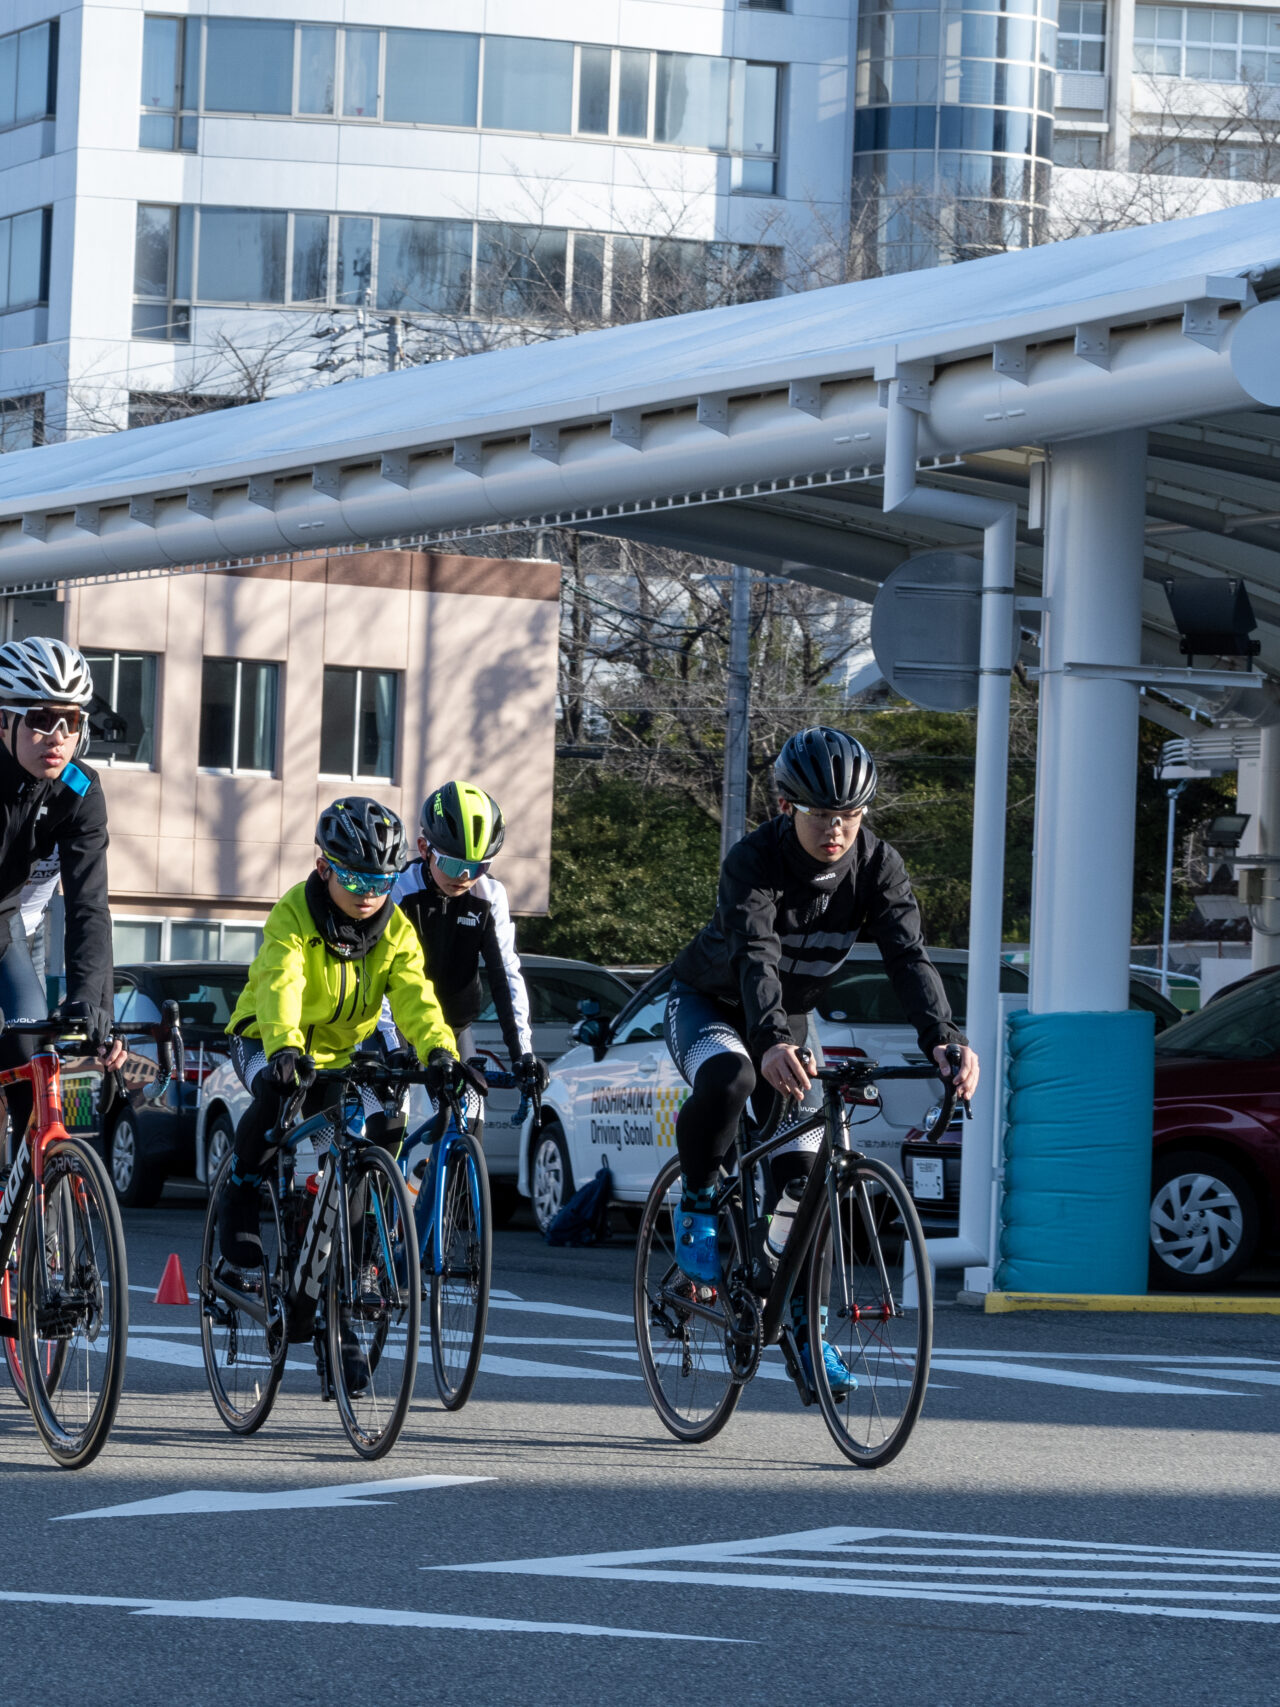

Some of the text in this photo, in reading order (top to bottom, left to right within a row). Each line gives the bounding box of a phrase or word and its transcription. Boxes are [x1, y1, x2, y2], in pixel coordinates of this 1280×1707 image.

[433, 793, 443, 818] MET
[457, 916, 476, 927] PUMA
[590, 1087, 654, 1115] HOSHIGAOKA
[591, 1119, 654, 1151] Driving School
